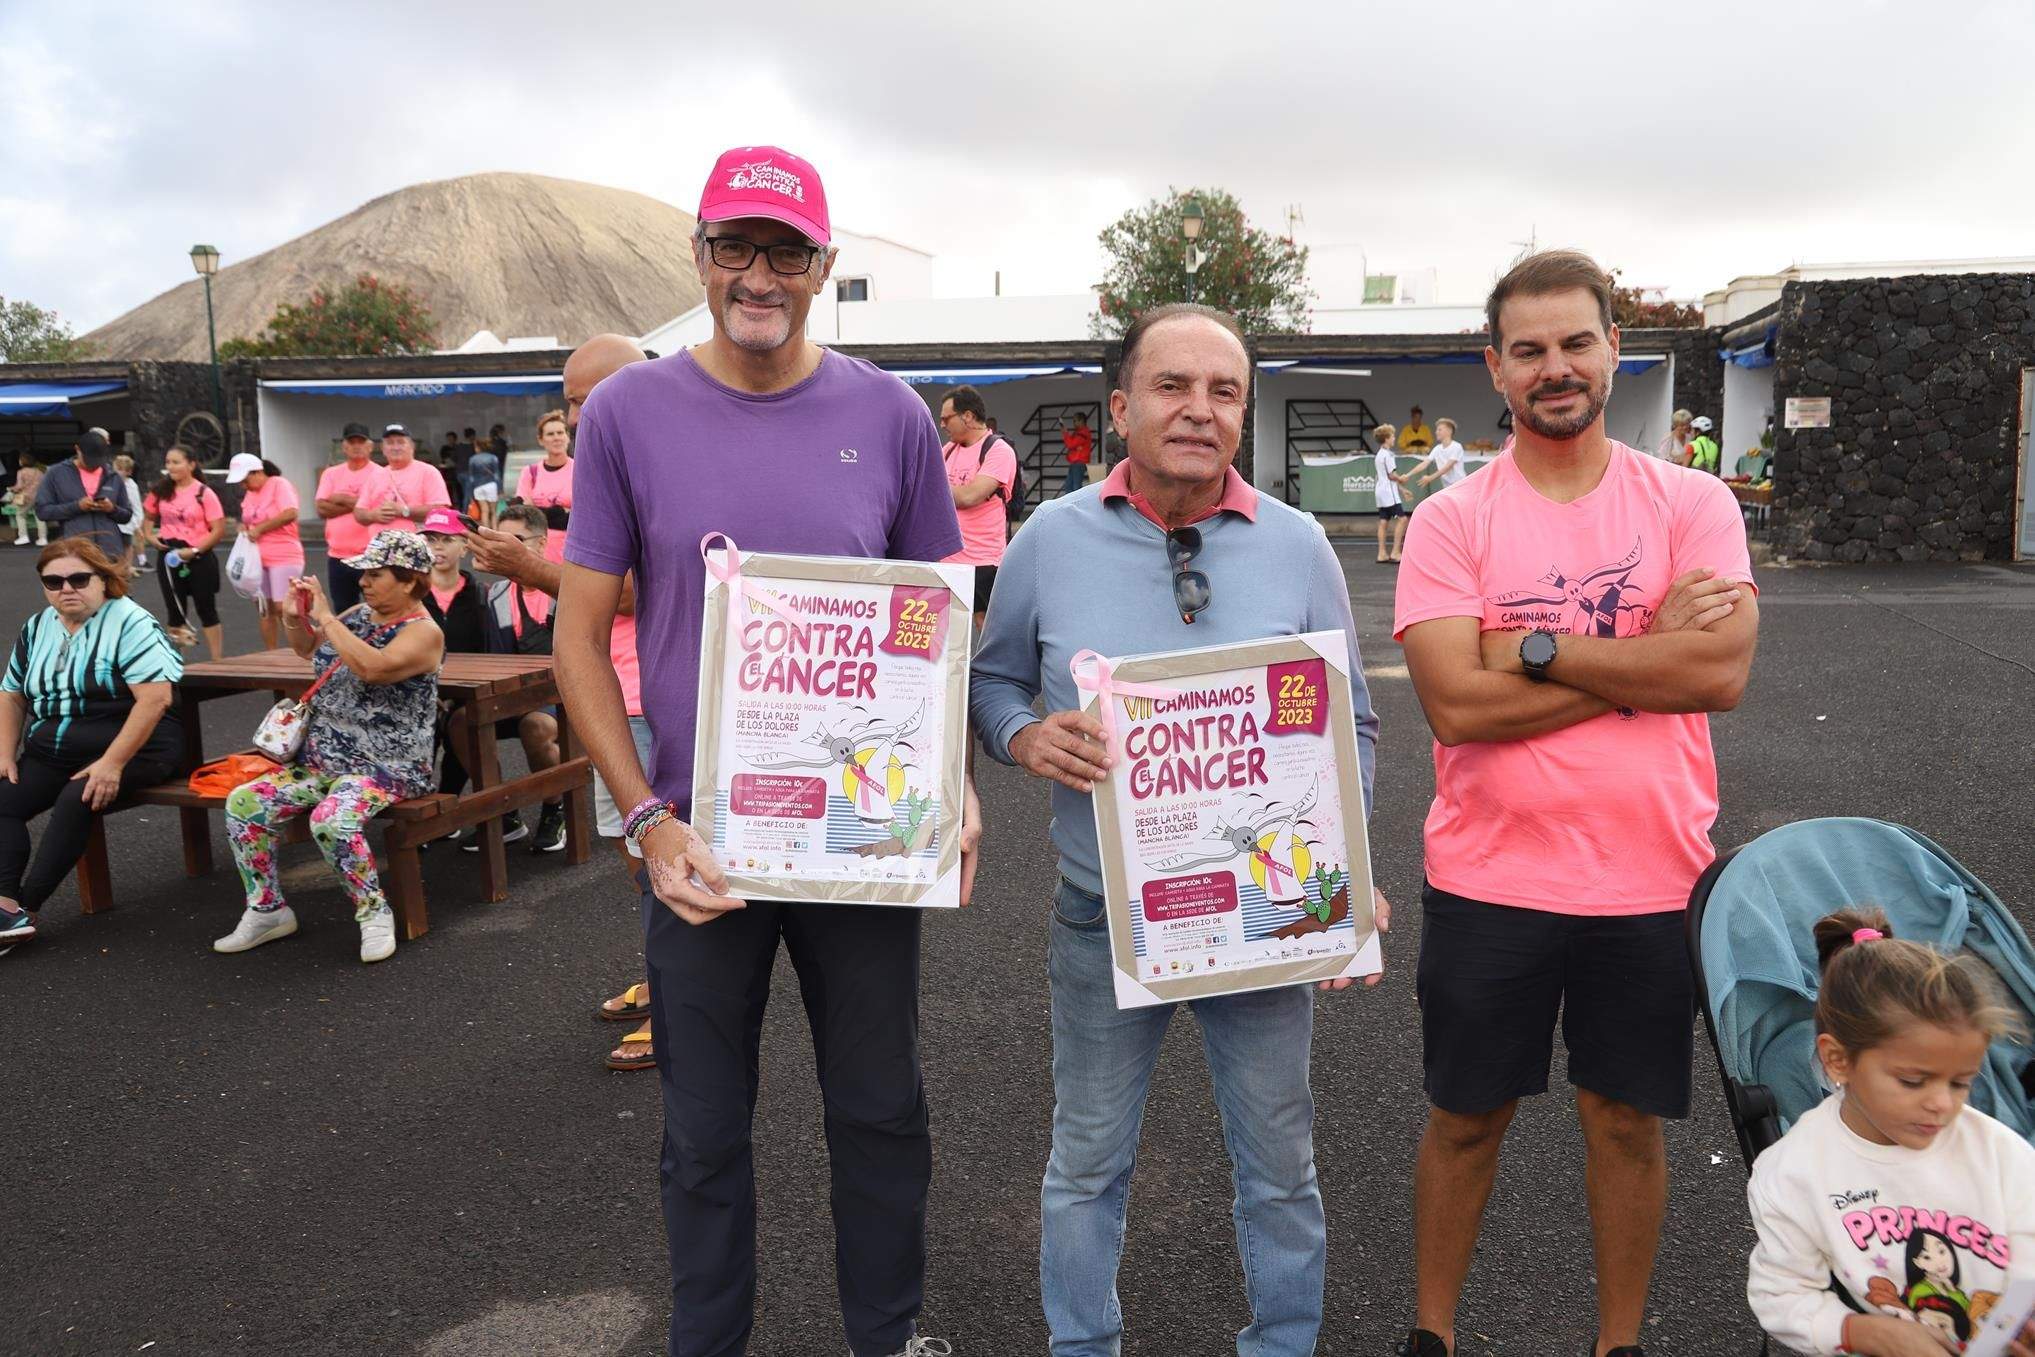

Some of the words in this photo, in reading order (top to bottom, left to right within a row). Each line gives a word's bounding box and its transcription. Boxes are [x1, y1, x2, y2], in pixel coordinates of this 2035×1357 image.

[756, 165, 800, 184] CAMINAMOS
[760, 172, 795, 188] CONTRA
[900, 598, 929, 622] 22
[925, 612, 938, 624] DE
[1501, 612, 1561, 623] CAMINAMOS
[897, 621, 937, 633] OCTUBRE
[742, 620, 874, 658] CONTRA
[894, 630, 930, 650] 2023
[750, 663, 765, 676] EL
[1279, 674, 1306, 699] 22
[1304, 685, 1316, 697] DE
[738, 699, 761, 708] SALIDA
[770, 702, 784, 710] LAS
[803, 703, 827, 712] HORAS
[1124, 696, 1152, 721] VII
[1278, 698, 1317, 708] OCTUBRE
[736, 709, 760, 719] DESDE
[762, 711, 773, 720] LA
[775, 711, 800, 721] PLAZA
[1277, 708, 1313, 726] 2023
[736, 720, 745, 729] DE
[747, 720, 763, 730] LOS
[764, 722, 799, 731] DOLORES
[1125, 711, 1259, 760] CONTRA
[1140, 769, 1155, 782] EL
[867, 780, 885, 795] AFOL
[1134, 807, 1158, 816] SALIDA
[1166, 804, 1180, 812] LAS
[1199, 798, 1222, 808] HORAS
[753, 820, 795, 829] BENEFICIO
[1135, 816, 1158, 828] DESDE
[1160, 815, 1171, 824] LA
[1172, 811, 1198, 822] PLAZA
[1136, 828, 1146, 838] DE
[1147, 826, 1163, 836] LOS
[1164, 821, 1198, 834] DOLORES
[1137, 836, 1163, 845] (MANCHA
[1274, 863, 1292, 876] AFOL
[1169, 919, 1211, 930] BENEFICIO
[1828, 1189, 1879, 1210] Disney
